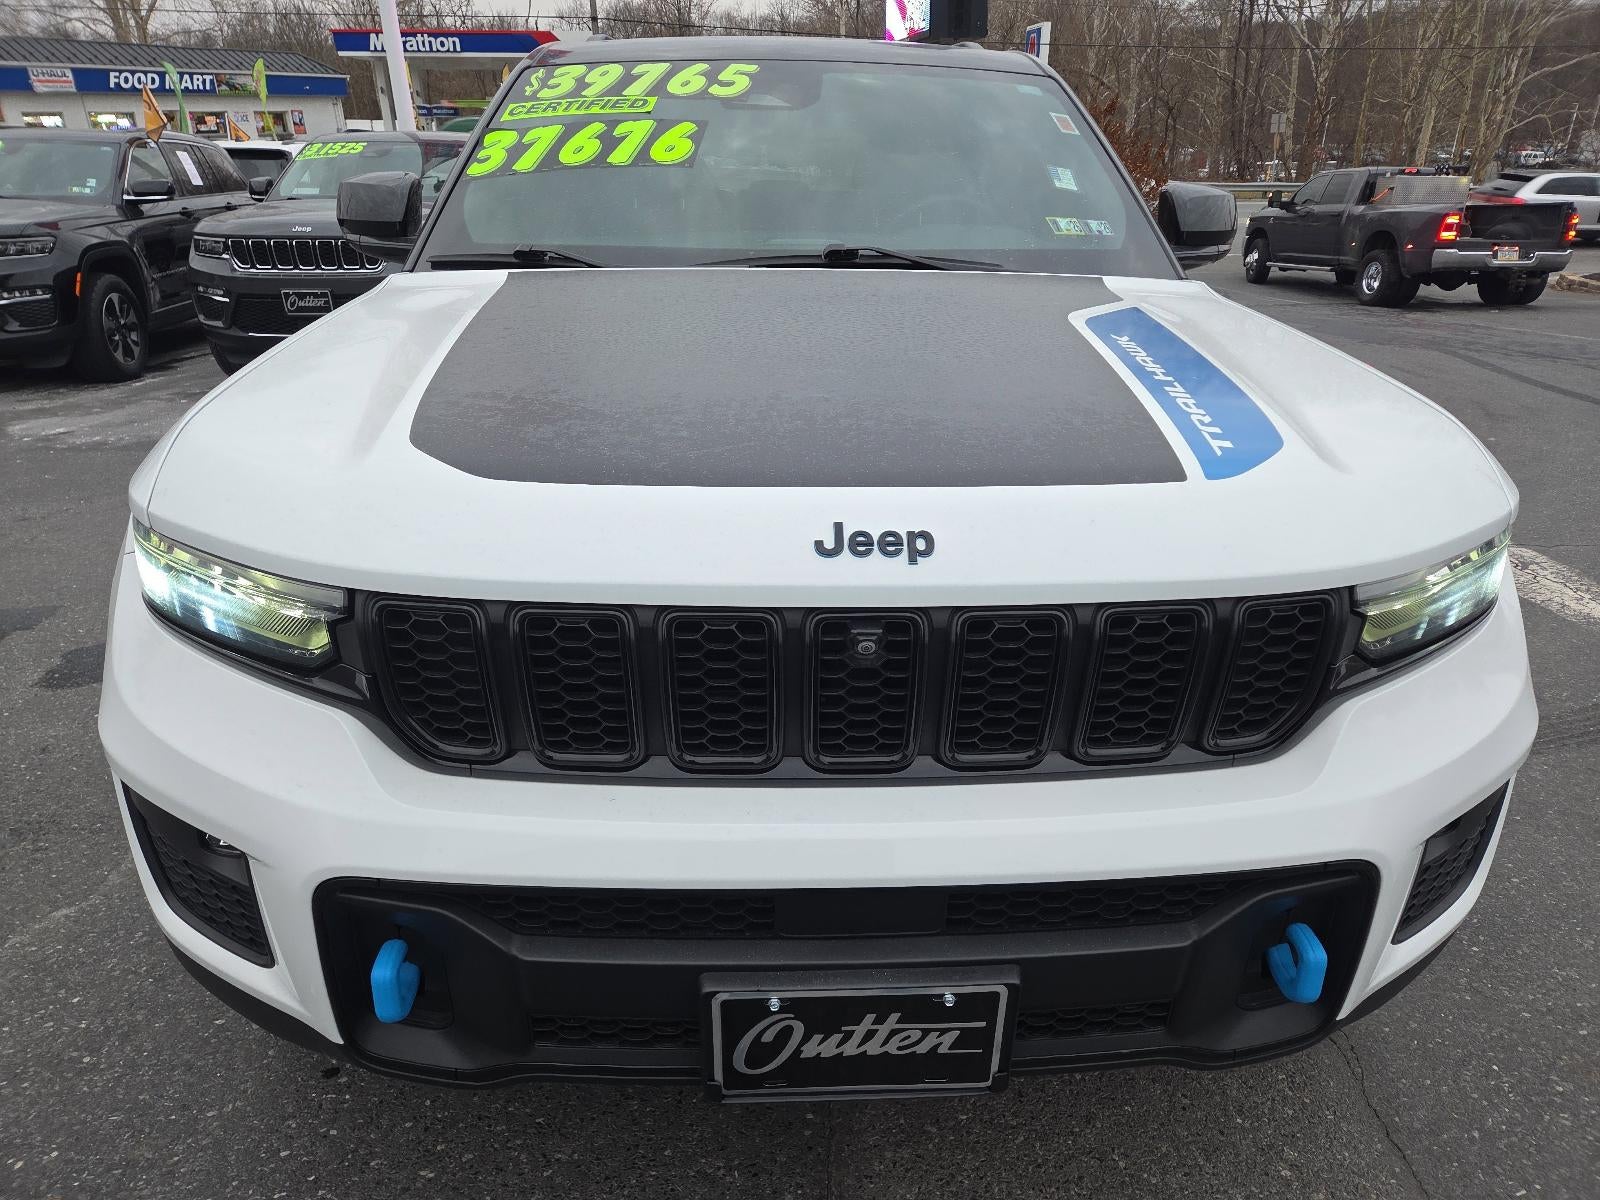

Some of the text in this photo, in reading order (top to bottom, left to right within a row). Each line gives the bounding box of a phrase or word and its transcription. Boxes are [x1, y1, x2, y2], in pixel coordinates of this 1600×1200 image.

[369, 33, 461, 52] Mrathon
[31, 69, 70, 78] U-HAUL
[109, 71, 160, 89] FOOD
[524, 62, 760, 98] $39765
[507, 97, 651, 116] CERTIFIED
[466, 119, 699, 177] 37676
[291, 225, 312, 233] Jeep
[287, 294, 330, 310] Outten
[1110, 333, 1235, 457] TRAILHAWK
[813, 521, 935, 565] Jeep
[732, 1013, 987, 1075] Outten
